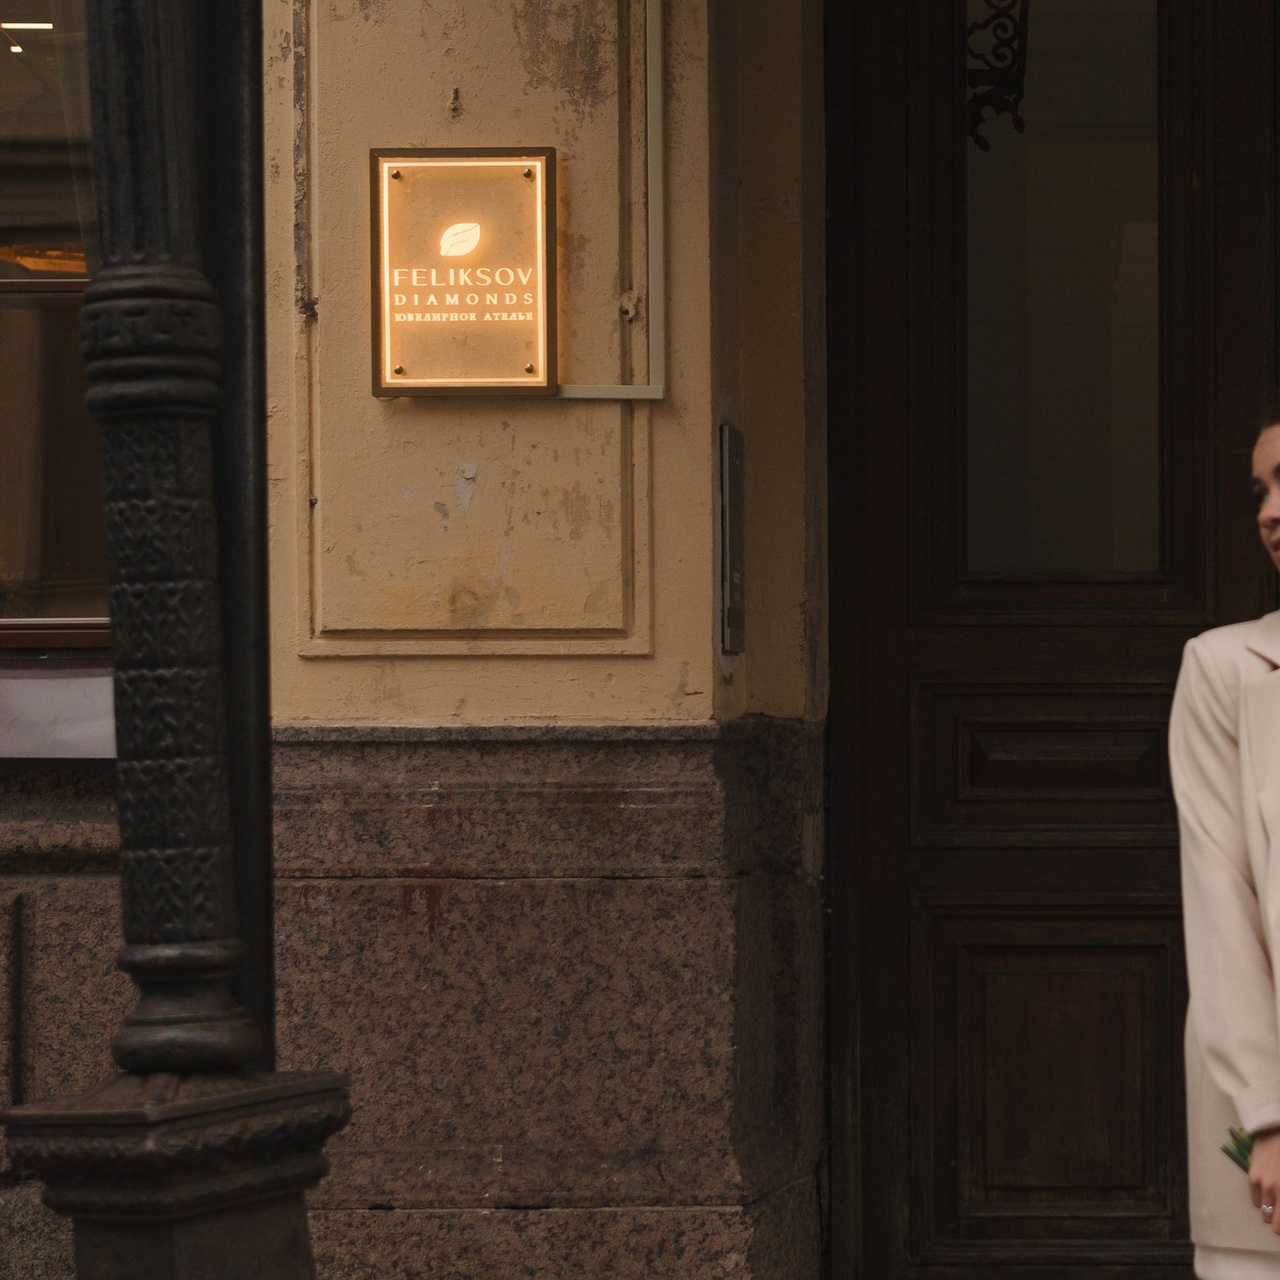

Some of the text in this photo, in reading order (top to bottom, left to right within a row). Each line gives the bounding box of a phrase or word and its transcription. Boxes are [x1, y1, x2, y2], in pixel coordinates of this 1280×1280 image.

[393, 267, 532, 286] FELIKSOV
[394, 293, 533, 306] DIAMONDS
[395, 312, 533, 322] ЮВЕЛИРНОЕ АТЕЛЬЕ
